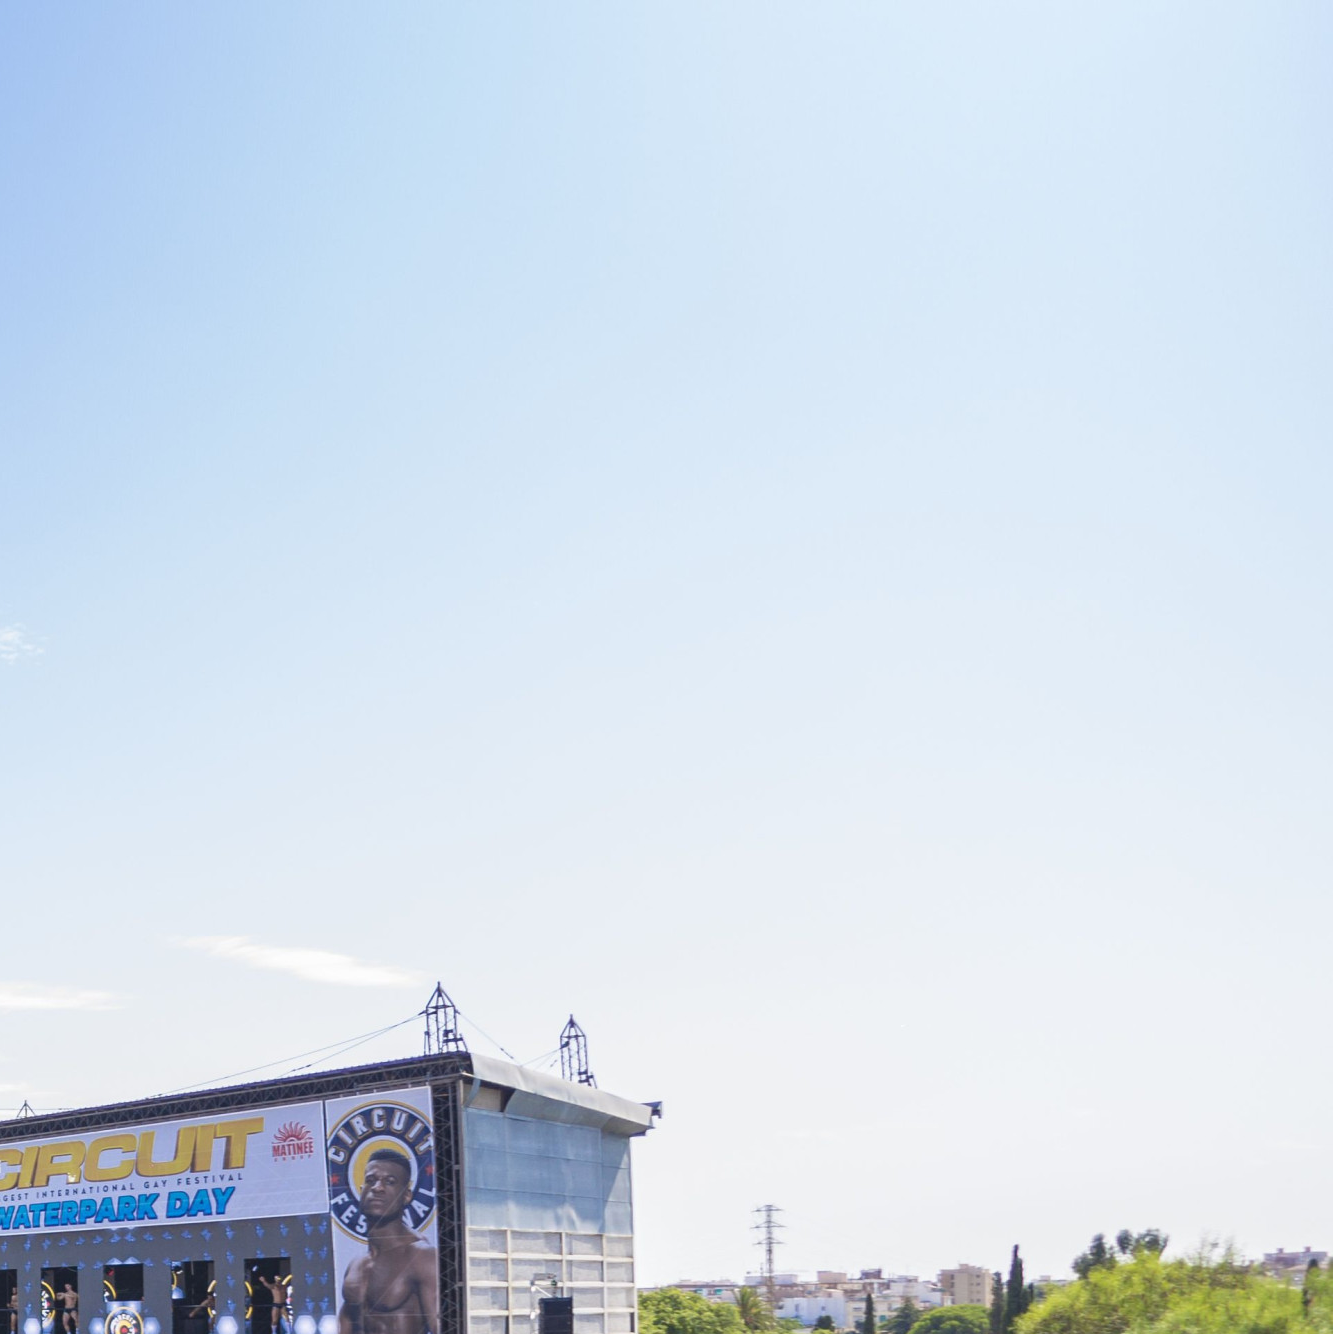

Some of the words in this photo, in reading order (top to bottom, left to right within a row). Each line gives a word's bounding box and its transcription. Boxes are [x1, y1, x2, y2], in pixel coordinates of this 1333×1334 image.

[272, 1141, 314, 1157] MATINEE
[328, 1108, 433, 1163] CIRCUIT
[36, 1182, 135, 1198] INTERNATIONAL
[144, 1180, 167, 1189] GAY
[177, 1173, 243, 1186] FESTIVAL
[166, 1186, 235, 1218] DAY
[331, 1186, 436, 1234] FESVAL
